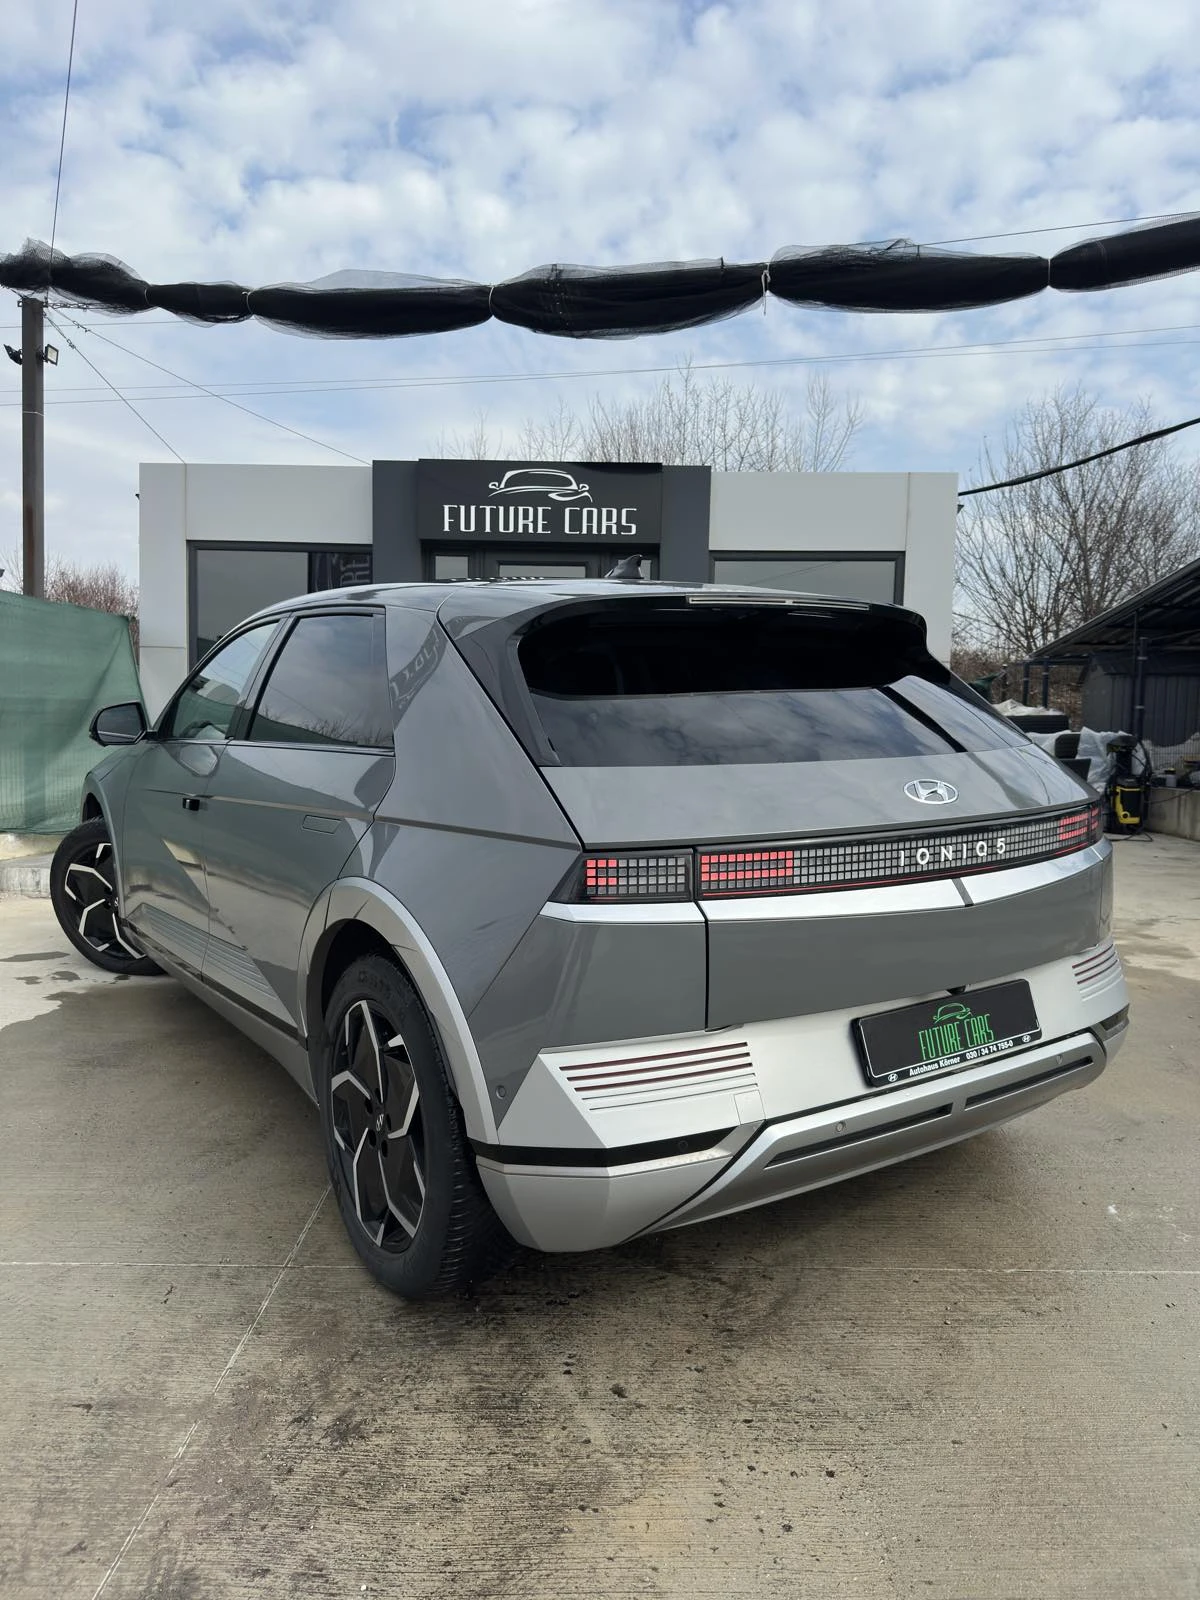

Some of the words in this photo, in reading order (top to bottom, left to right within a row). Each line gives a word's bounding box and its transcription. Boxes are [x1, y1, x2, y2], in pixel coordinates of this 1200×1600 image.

[443, 505, 551, 534] FUTURE
[564, 507, 637, 535] CARS
[918, 1021, 964, 1060] FUTURE
[964, 1013, 994, 1047] CARS
[909, 1063, 939, 1076] Autohaus
[939, 1055, 960, 1068] Körner
[966, 1050, 977, 1060] 030
[989, 1044, 997, 1053] 74
